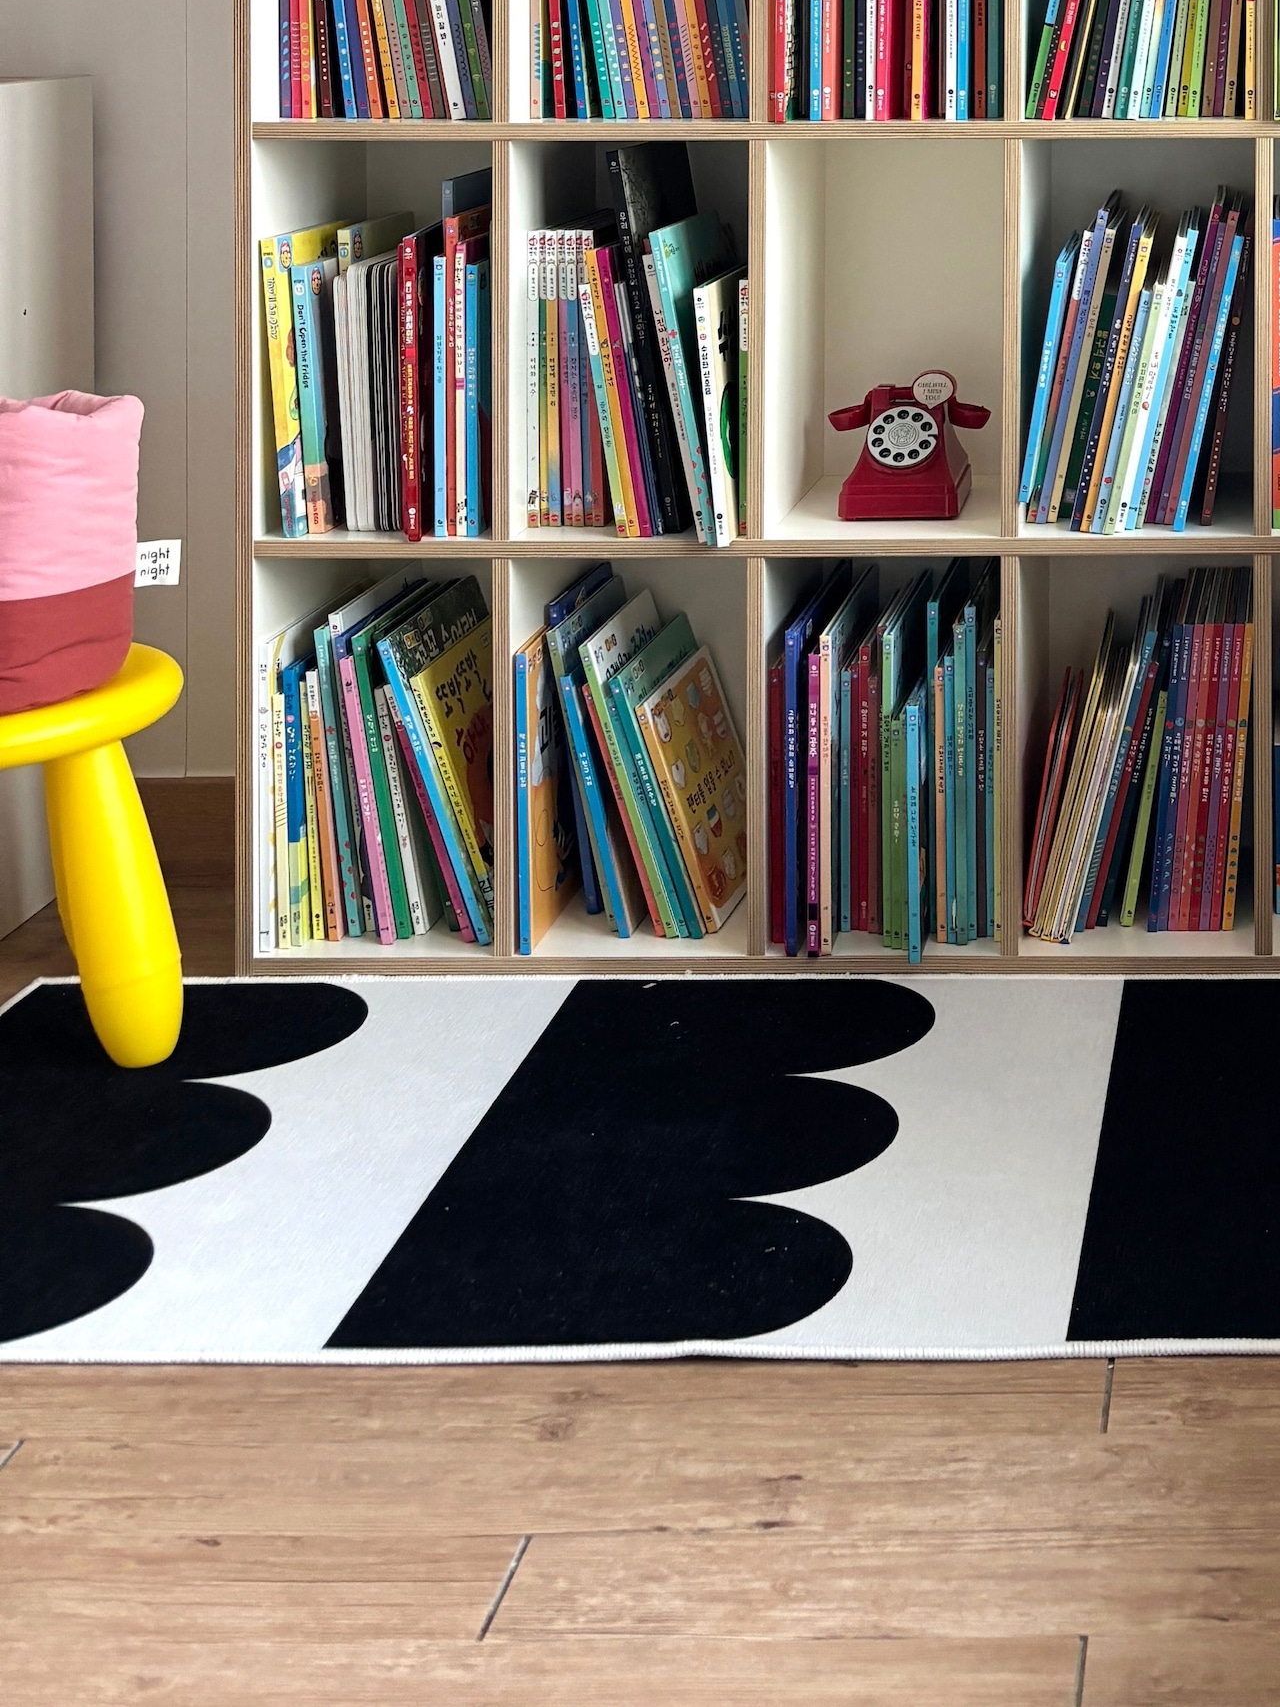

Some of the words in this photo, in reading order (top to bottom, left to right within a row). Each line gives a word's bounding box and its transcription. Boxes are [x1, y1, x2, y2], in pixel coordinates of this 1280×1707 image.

[620, 212, 628, 230] 우리
[297, 304, 306, 325] Don't
[299, 325, 307, 348] Open
[302, 363, 310, 388] Fridge
[140, 547, 170, 564] night
[140, 564, 170, 580] night
[809, 702, 816, 716] 하나
[809, 736, 817, 758] 공주
